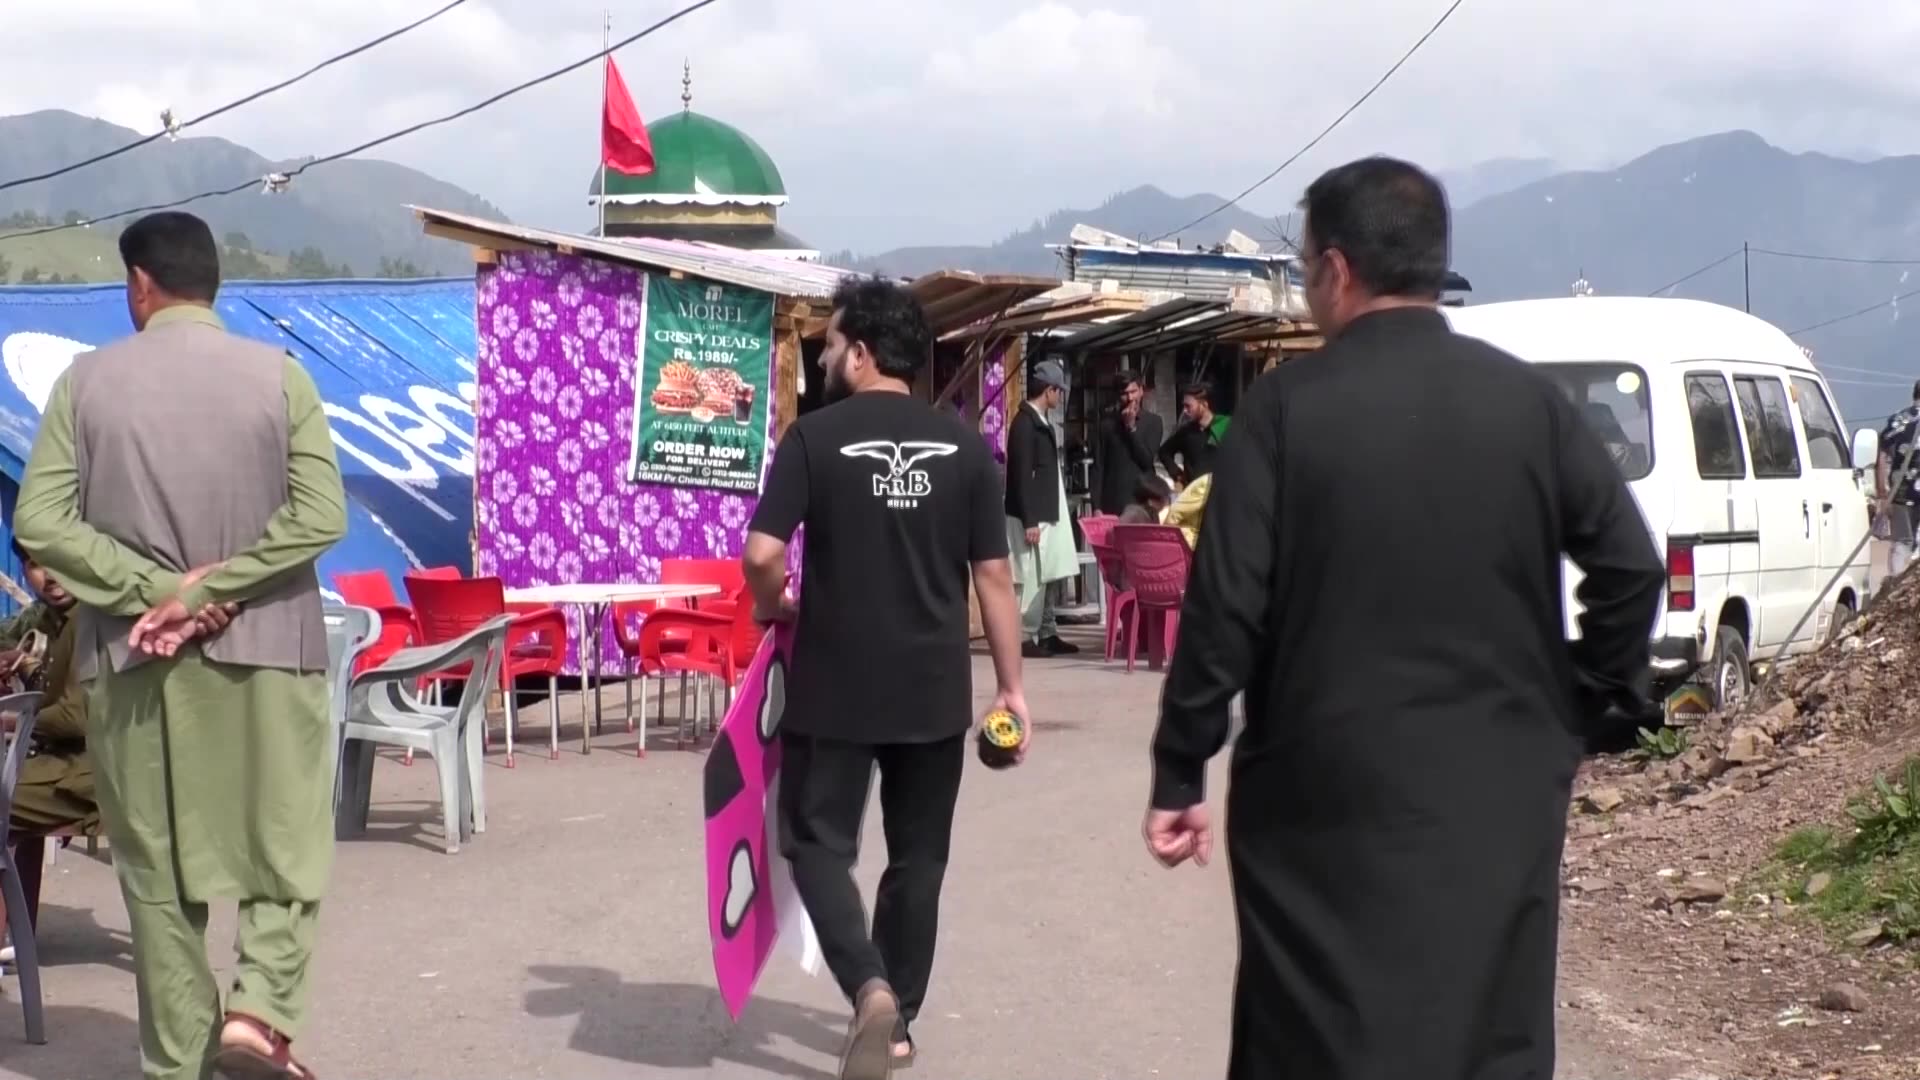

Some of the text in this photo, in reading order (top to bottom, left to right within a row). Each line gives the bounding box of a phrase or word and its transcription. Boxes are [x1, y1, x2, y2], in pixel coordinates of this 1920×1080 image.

[678, 301, 747, 323] MOREL
[654, 329, 760, 350] CRISPY DEALS
[685, 423, 704, 433] FEET
[653, 441, 745, 459] ORDER NOW
[665, 454, 731, 468] FOR DELIVERY
[637, 470, 756, 490] 16KM Pir Chinasi Road MZD
